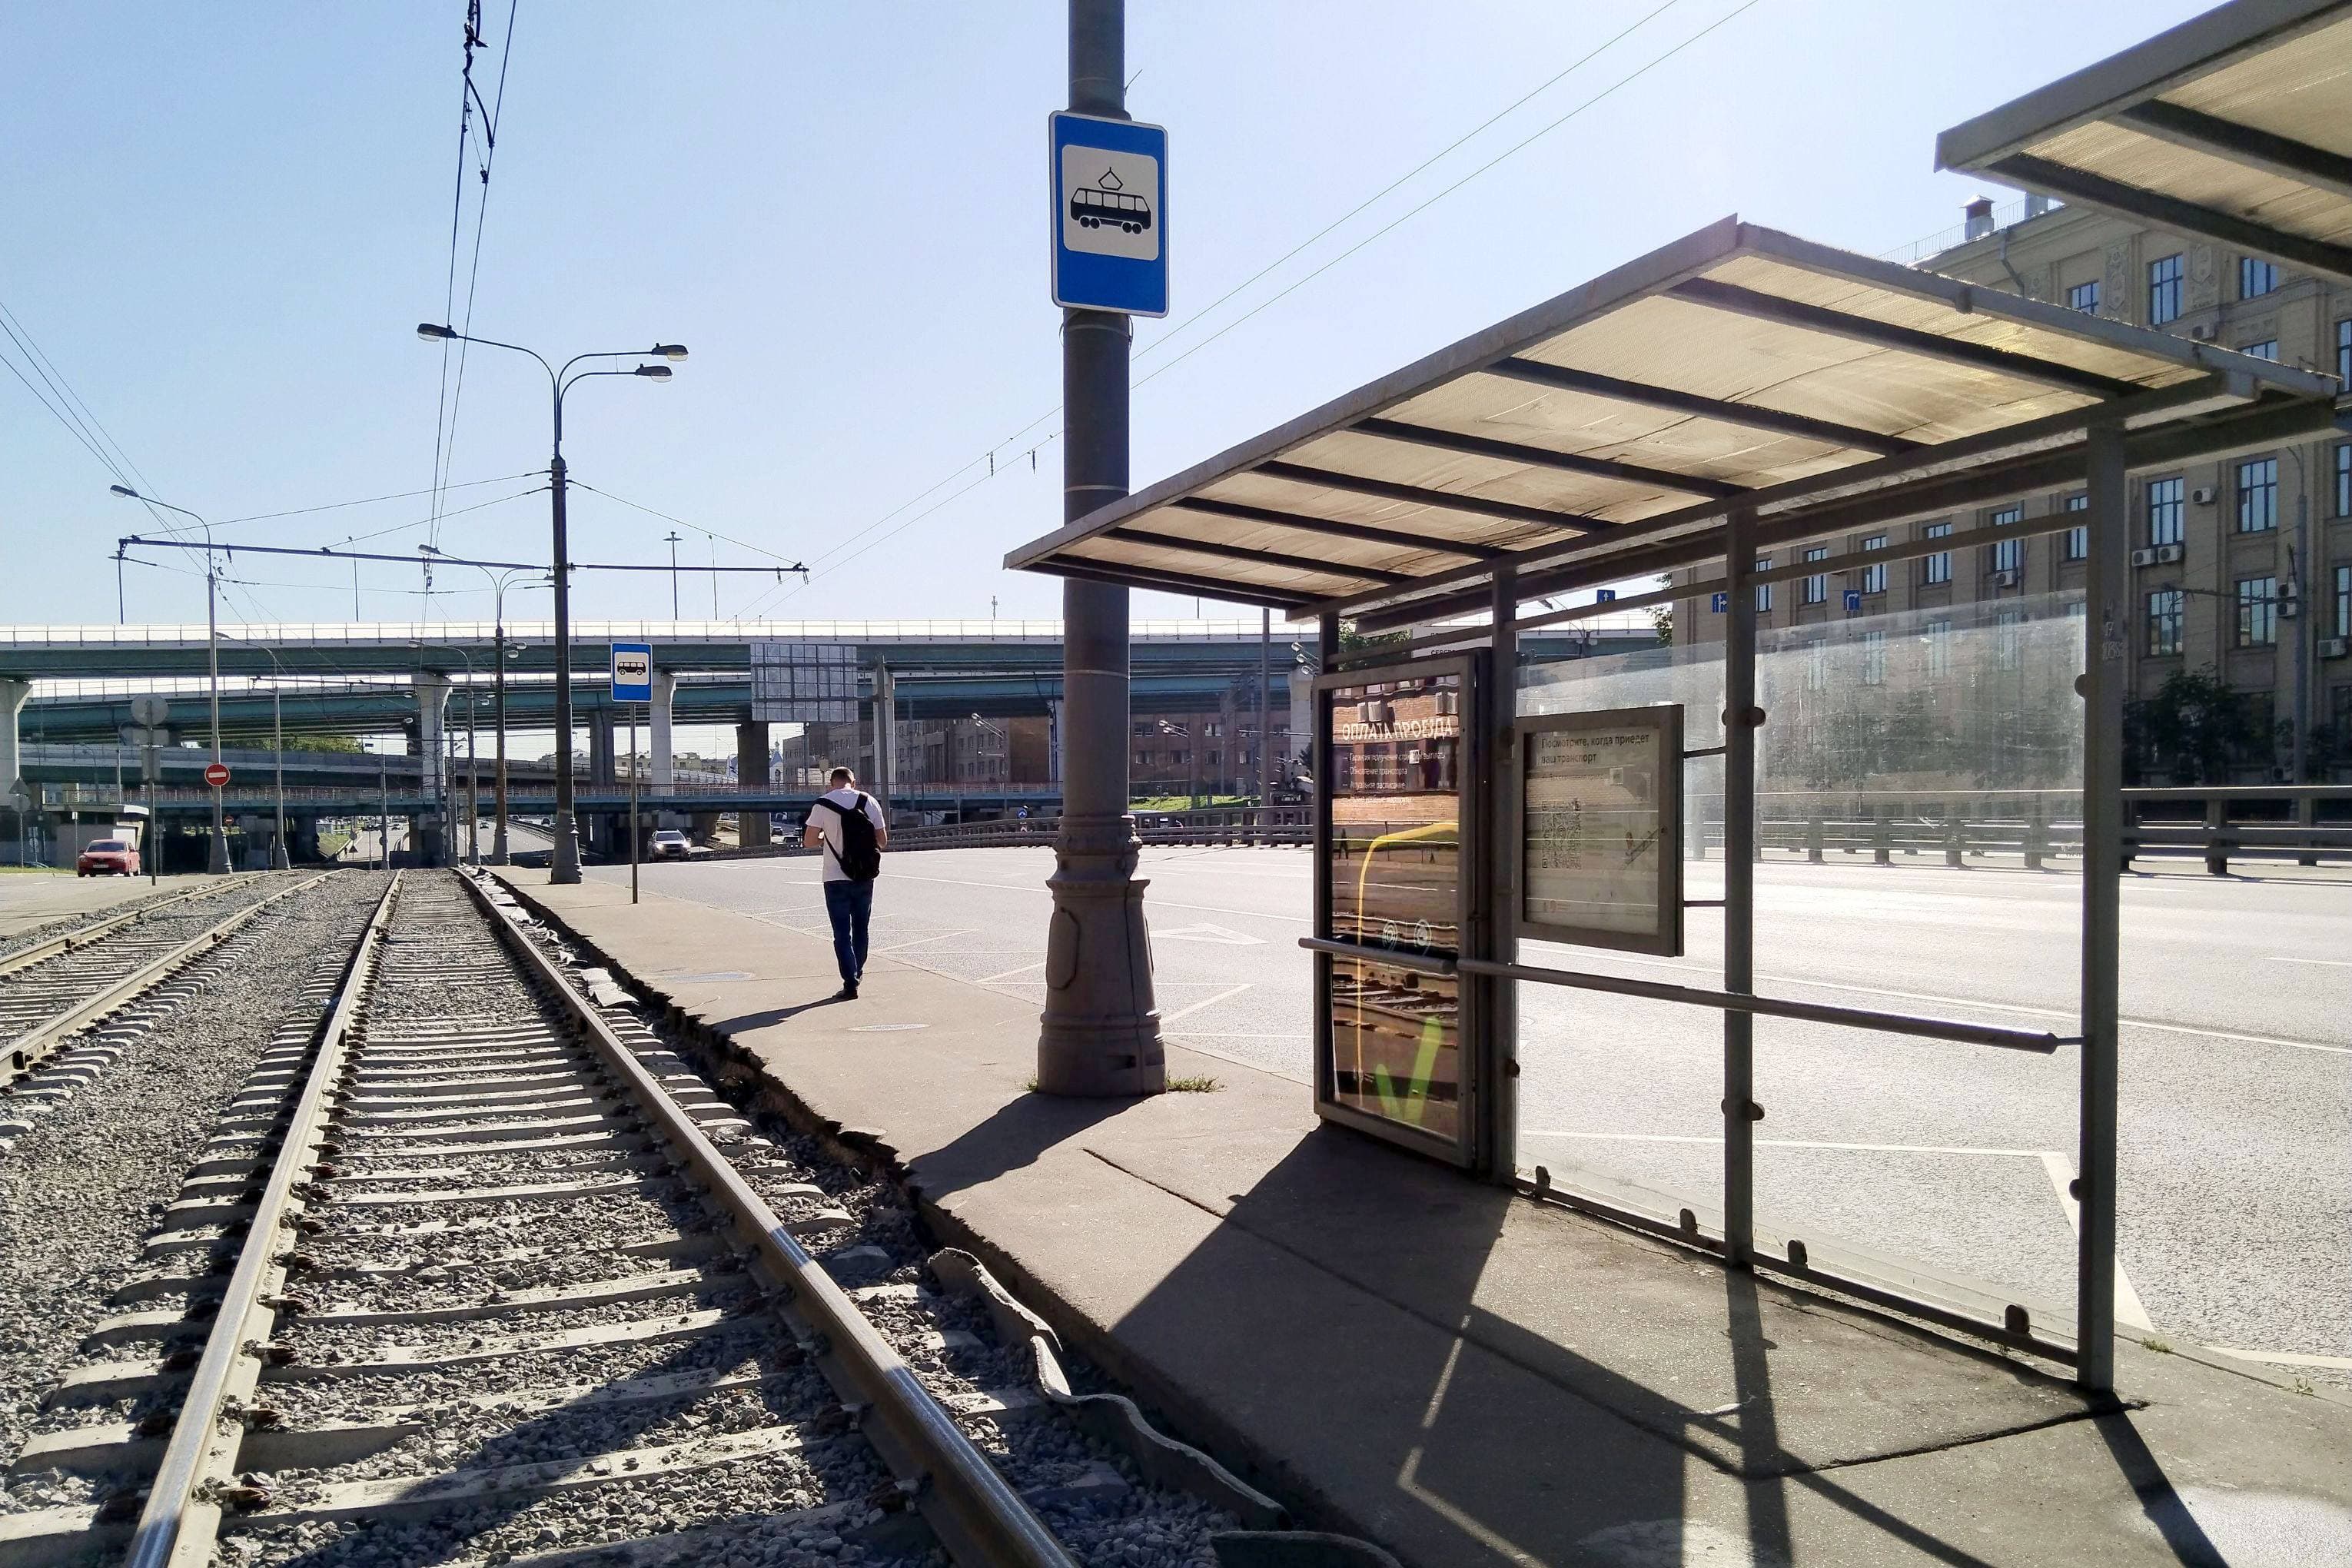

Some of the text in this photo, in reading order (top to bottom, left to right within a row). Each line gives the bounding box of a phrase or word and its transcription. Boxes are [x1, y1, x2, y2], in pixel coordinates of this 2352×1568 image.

[1342, 716, 1453, 740] ОПЛАТА ПРОЕЗДА
[1541, 733, 1649, 749] Посмотрите, когда приедет
[1541, 753, 1597, 765] ваш транспорт
